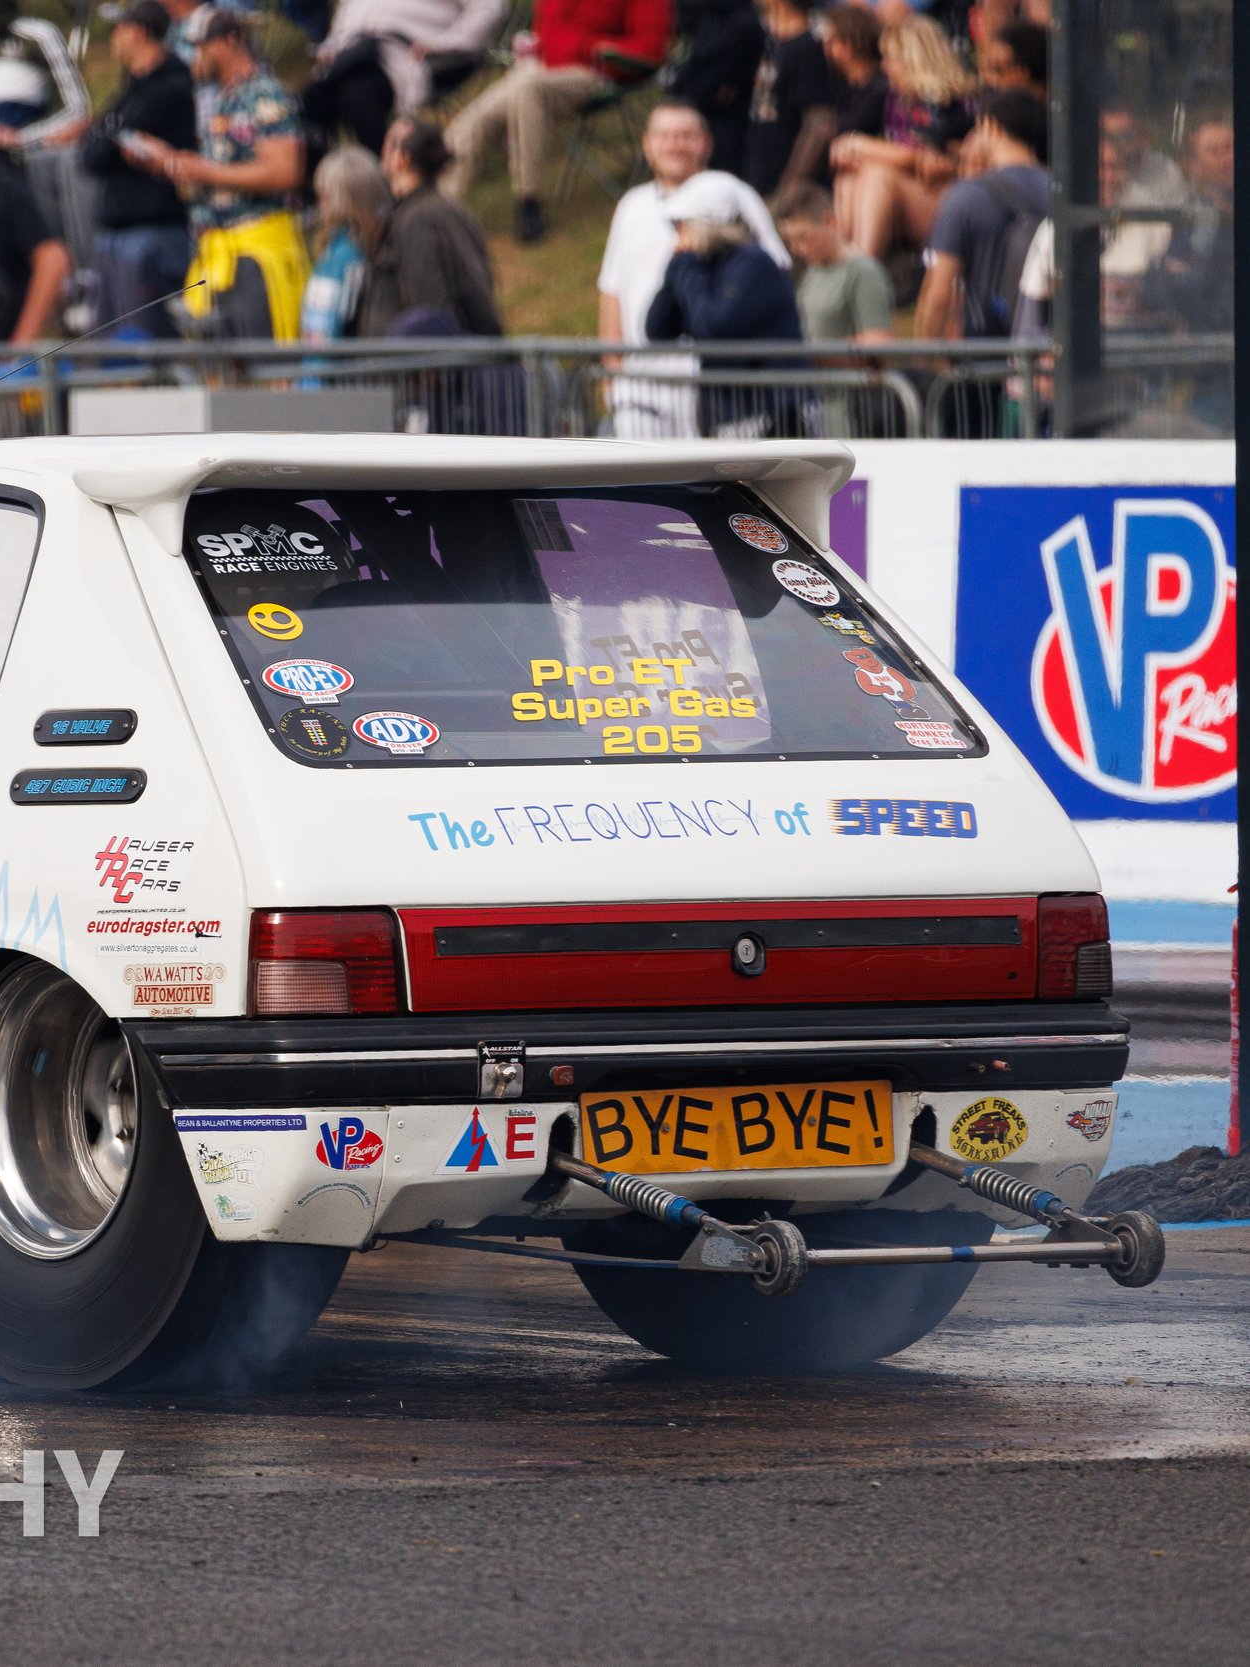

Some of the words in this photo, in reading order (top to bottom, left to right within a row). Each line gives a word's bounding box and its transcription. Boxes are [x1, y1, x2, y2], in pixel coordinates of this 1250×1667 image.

[197, 531, 325, 558] SPMC
[212, 562, 262, 574] RACE
[267, 560, 338, 572] ENGINES
[1040, 498, 1228, 793] VP
[273, 659, 332, 670] CHAMPIONSHIP
[530, 658, 615, 687] Pro
[632, 657, 693, 685] ET
[279, 665, 340, 691] PRO-ET
[290, 689, 313, 697] DRAG
[314, 687, 342, 697] RACING
[365, 712, 381, 720] RIDE
[511, 691, 651, 725] Super
[669, 689, 757, 719] Gas
[52, 720, 70, 735] 16
[70, 719, 113, 735] VALVE
[370, 718, 424, 743] ADY
[897, 722, 953, 731] NORTHERN
[602, 724, 703, 755] 205
[910, 738, 931, 747] Drag
[934, 738, 966, 748] Racing
[24, 779, 52, 794] 427
[50, 778, 92, 794] CUBIC
[90, 778, 128, 793] INCH
[407, 811, 496, 852] The
[494, 798, 761, 846] FREQUENCY
[774, 802, 812, 837] of
[826, 798, 979, 839] SPEED
[87, 917, 221, 937] eurodragster.com
[135, 986, 211, 1003] AUTOMOTIVE
[201, 1119, 242, 1127] BALLANTYNE
[243, 1119, 287, 1127] PROPERTIES
[287, 1118, 303, 1126] LTD
[586, 1095, 714, 1165] BYE
[731, 1088, 887, 1157] BYE!
[951, 1100, 987, 1135] STREET
[992, 1099, 1026, 1131] FREAKS
[319, 1116, 365, 1170] VP
[505, 1116, 537, 1160] E
[346, 1144, 384, 1164] Racing
